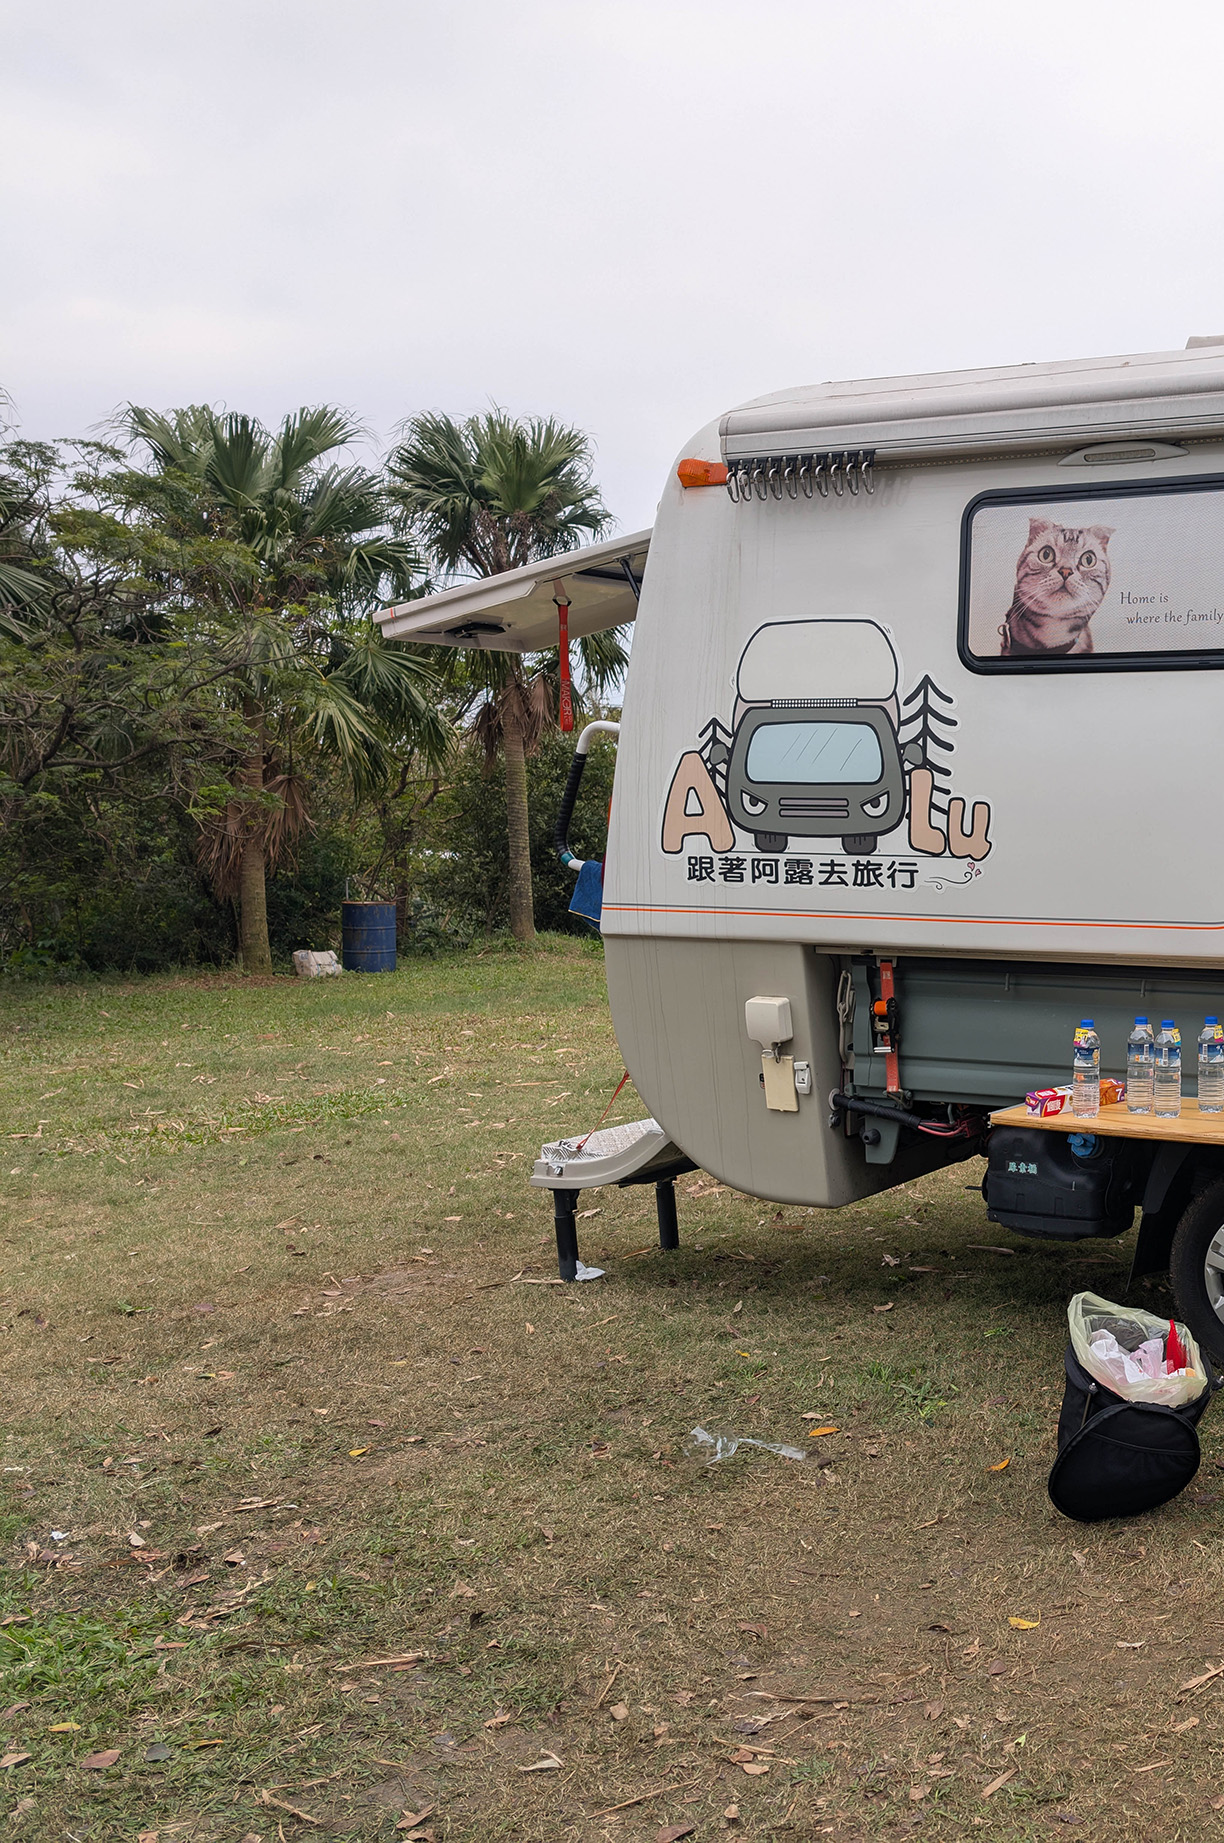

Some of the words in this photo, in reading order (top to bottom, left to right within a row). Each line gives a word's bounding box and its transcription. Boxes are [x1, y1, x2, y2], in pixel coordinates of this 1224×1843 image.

[1120, 591, 1155, 604] Home
[1160, 592, 1169, 603] is
[1126, 612, 1161, 624] where
[1164, 611, 1183, 623] the
[1183, 609, 1224, 626] family
[686, 856, 919, 889] 跟著阿露去旅行
